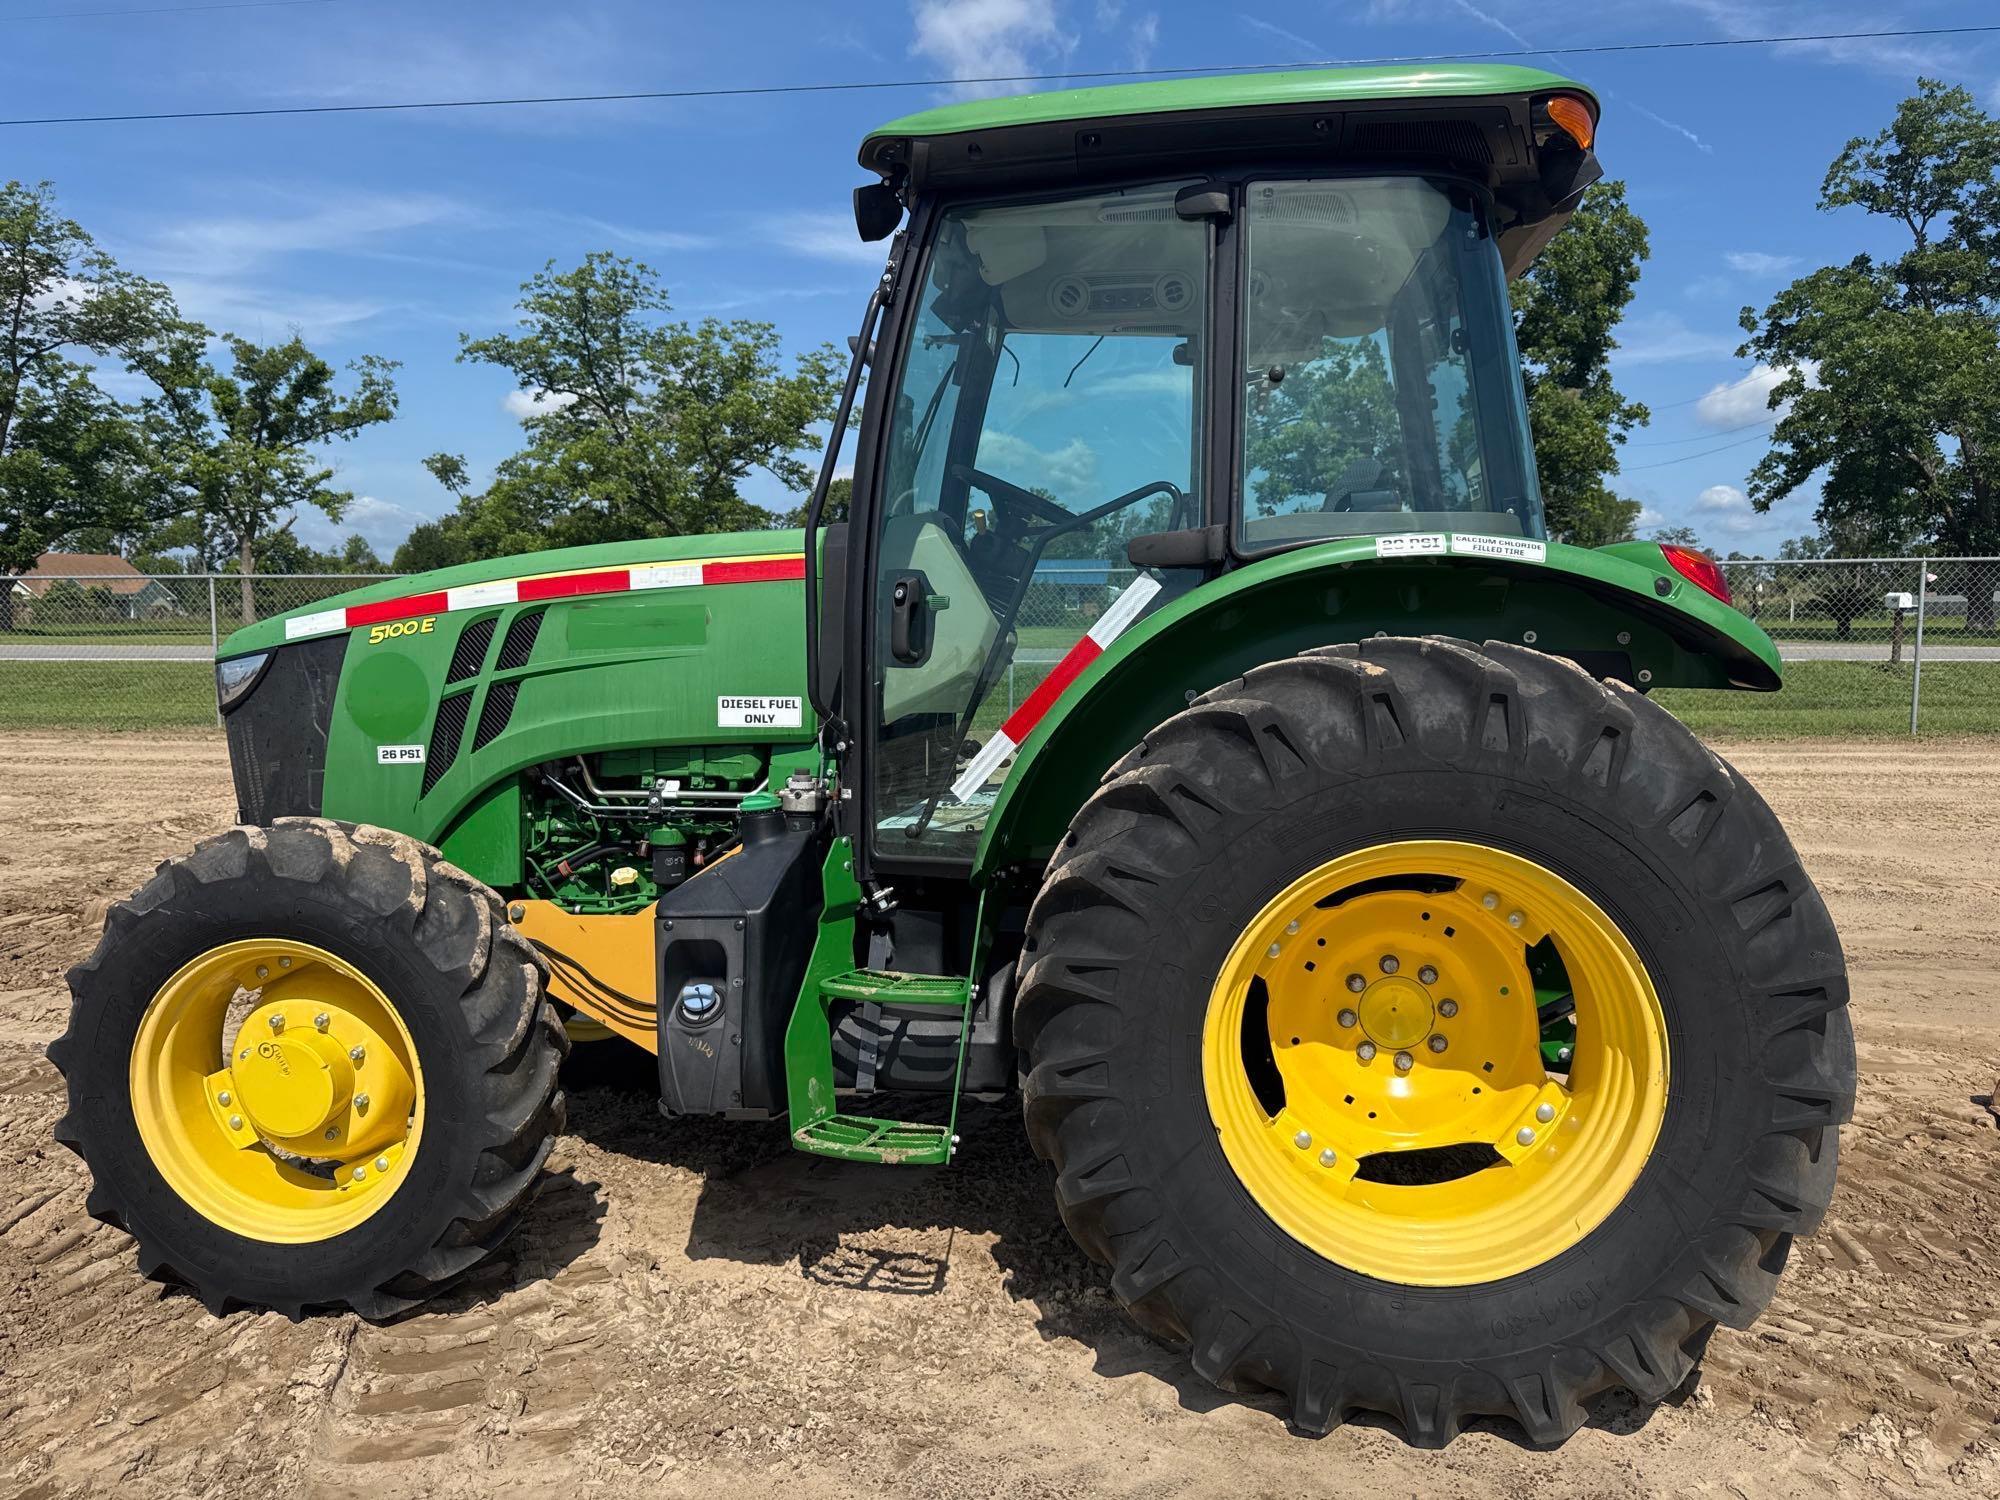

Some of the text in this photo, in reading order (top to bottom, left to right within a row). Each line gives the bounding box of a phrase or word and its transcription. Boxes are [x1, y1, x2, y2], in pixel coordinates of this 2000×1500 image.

[1409, 537, 1440, 549] PSI
[1455, 536, 1542, 551] CALCIUM CHLORIDE
[1473, 544, 1525, 556] FILLED TIRE
[368, 617, 437, 644] 5100 E
[721, 699, 798, 709] DIESEL FUEL
[744, 714, 776, 724] ONLY
[382, 749, 421, 759] 26 PSI
